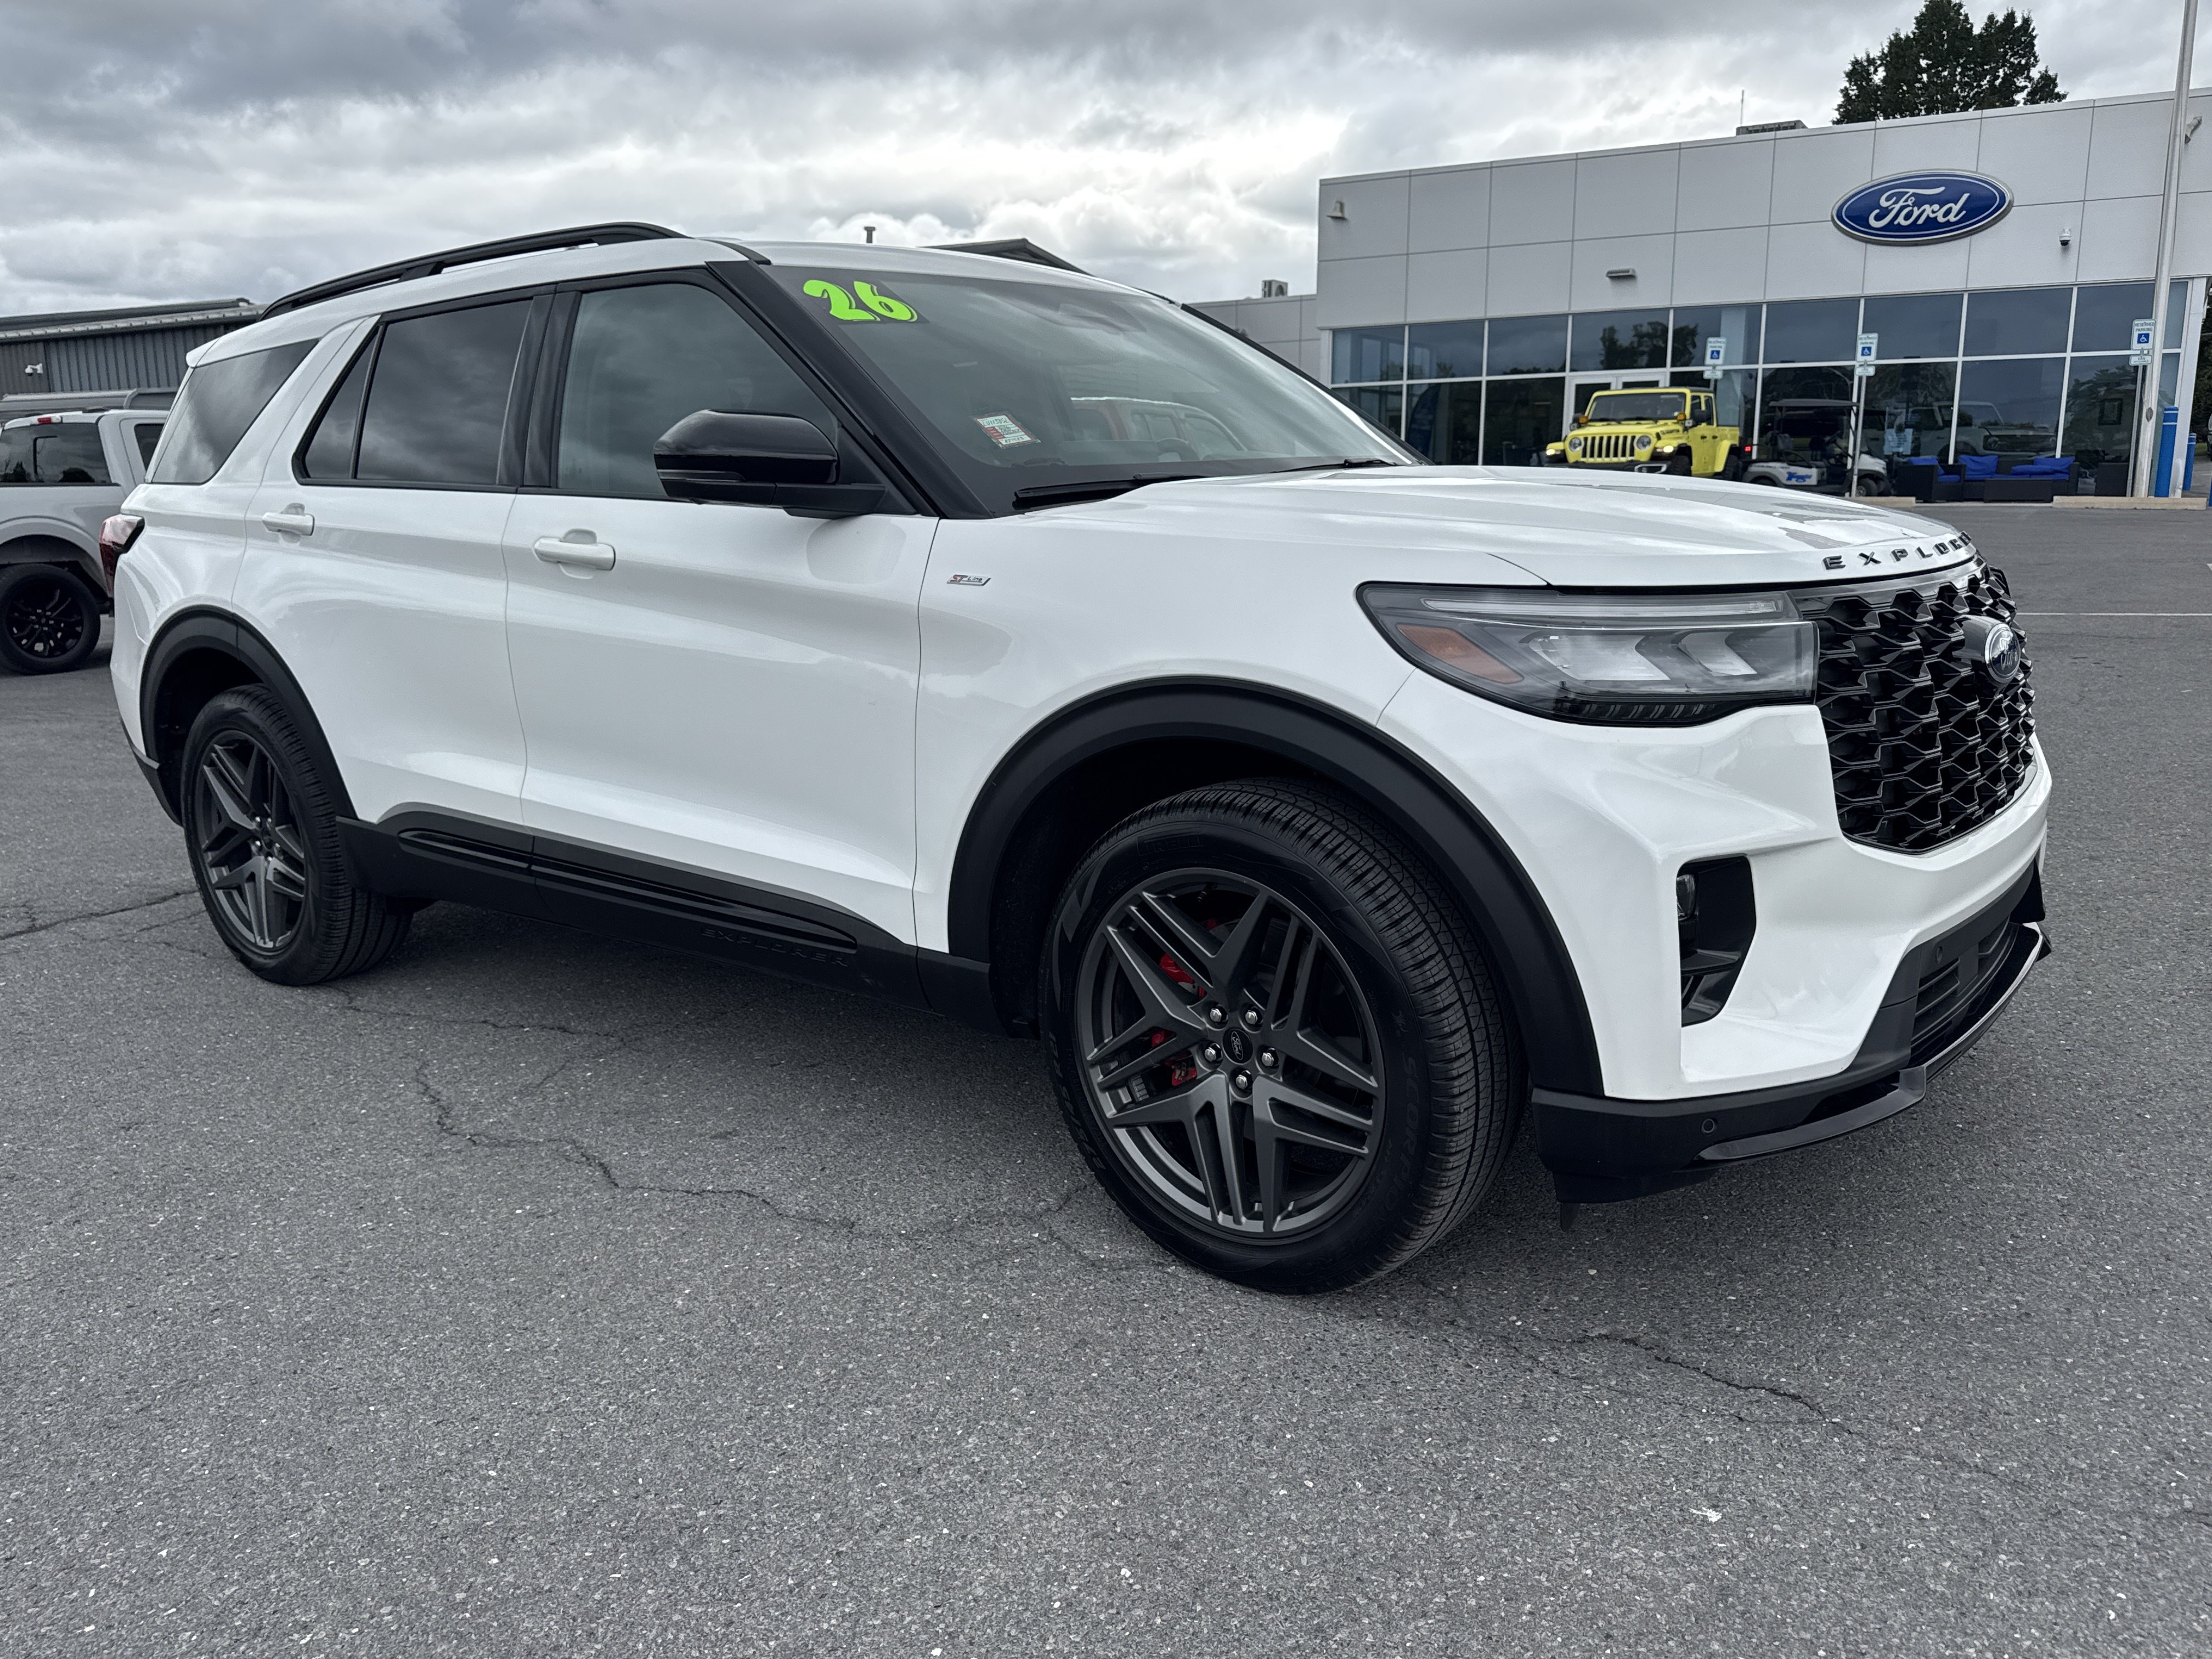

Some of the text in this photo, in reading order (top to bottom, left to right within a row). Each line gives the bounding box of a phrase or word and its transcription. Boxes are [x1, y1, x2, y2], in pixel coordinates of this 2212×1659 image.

[1868, 186, 1970, 228] Ford
[803, 279, 918, 323] 26
[702, 928, 848, 967] EXPLORER
[1232, 1036, 1242, 1056] Ford
